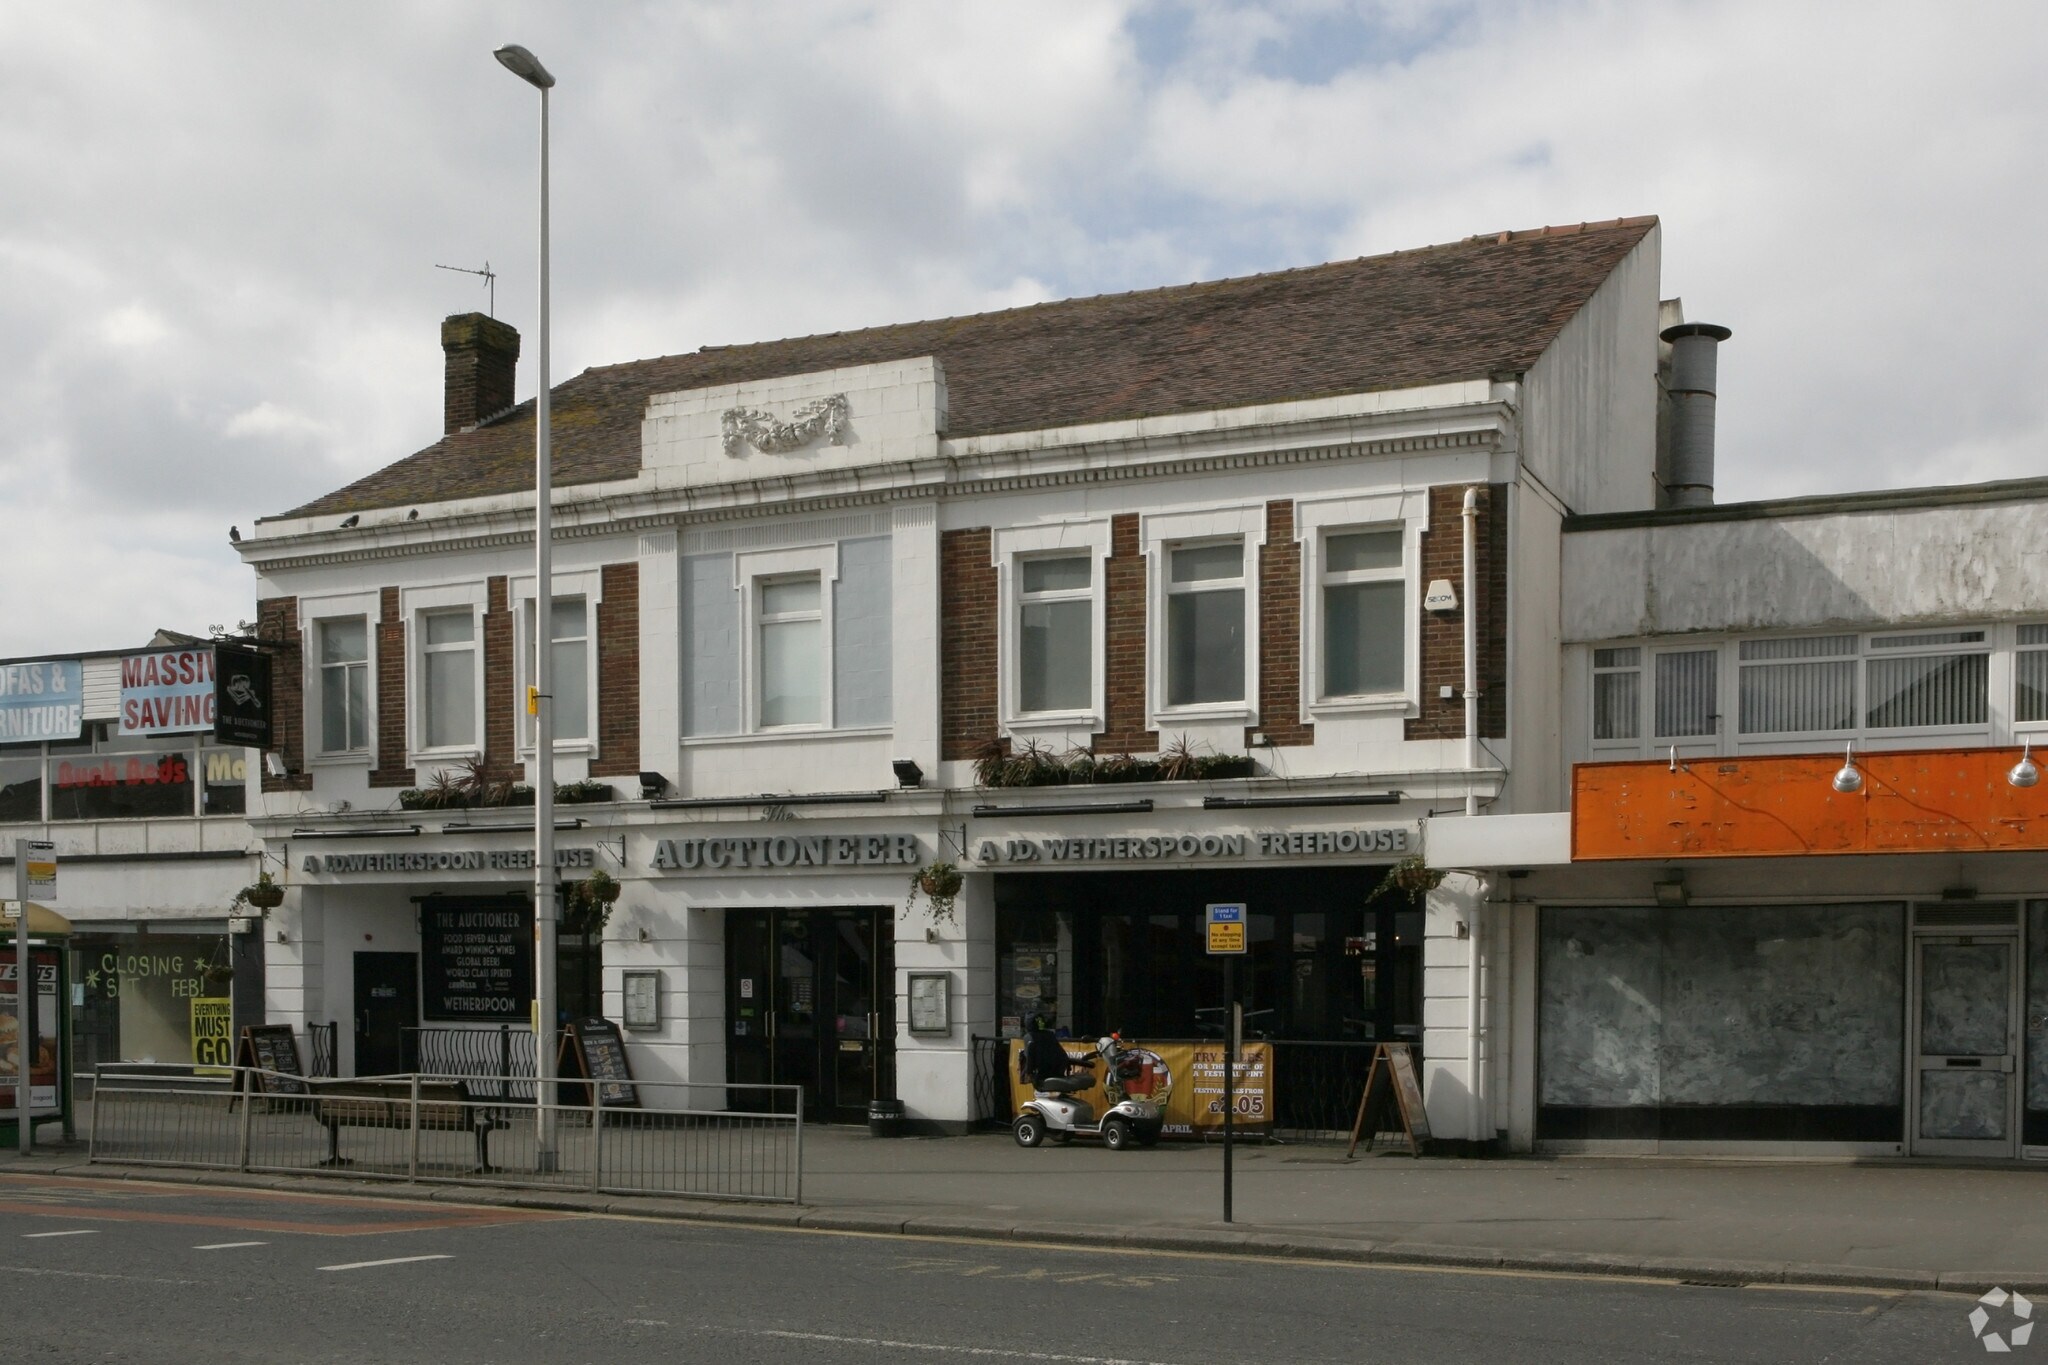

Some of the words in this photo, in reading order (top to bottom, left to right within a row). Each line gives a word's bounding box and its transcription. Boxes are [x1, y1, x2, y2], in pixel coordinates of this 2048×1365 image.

[52, 663, 67, 693] &
[760, 805, 794, 823] The
[650, 834, 919, 869] AUCTIONEER
[977, 840, 998, 861] A
[1257, 829, 1408, 856] FREEHOUSE
[302, 855, 319, 873] A
[487, 848, 595, 870] FREEHUSE
[437, 912, 454, 928] THE
[459, 912, 520, 928] AUCTIONEER
[444, 934, 463, 943] FOOD
[464, 934, 486, 944] SERVED
[487, 934, 498, 944] ALL
[499, 935, 512, 944] DAY
[441, 945, 463, 955] AWARD
[464, 945, 495, 955] WINNING
[496, 945, 516, 955] WINES
[102, 954, 184, 977] CLOSING
[456, 957, 481, 966] GLOBAL
[482, 957, 500, 967] BEERS
[446, 968, 470, 978] WORLD
[471, 968, 489, 978] CLASS
[490, 969, 512, 978] SPIRITS
[172, 975, 205, 998] FEB!
[195, 1003, 231, 1016] EVERYTHING
[443, 997, 516, 1012] WETHERSPOON
[195, 1017, 231, 1037] MUST
[196, 1038, 232, 1066] GO
[1193, 1053, 1217, 1063] TRY
[1161, 1124, 1193, 1134] APRIL
